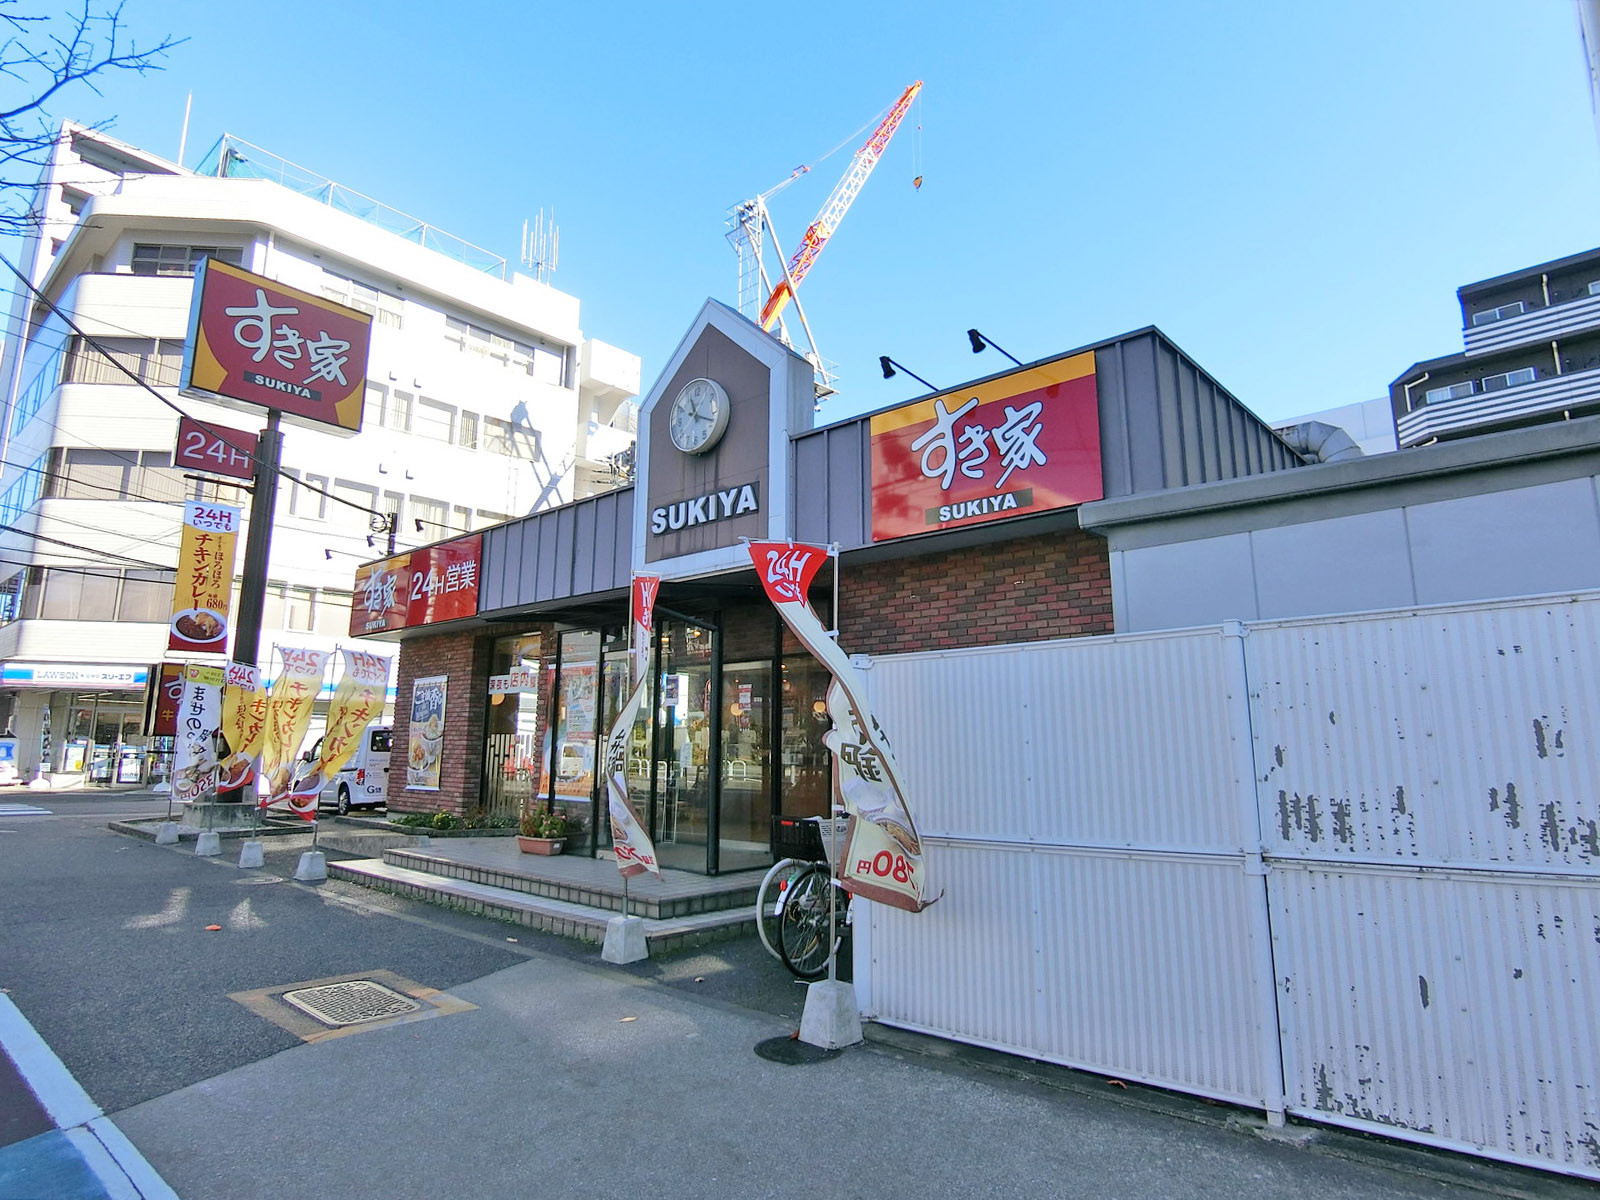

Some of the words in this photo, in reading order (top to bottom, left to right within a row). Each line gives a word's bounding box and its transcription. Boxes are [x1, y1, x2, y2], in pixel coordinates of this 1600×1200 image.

[225, 288, 351, 387] すき家
[254, 374, 312, 399] SUKIYA
[183, 431, 250, 469] 24H
[911, 396, 1047, 491] すき家
[193, 507, 232, 524] 24H
[651, 484, 758, 534] SUKIYA
[939, 492, 1018, 522] SUKIYA
[192, 519, 232, 532] いつでも
[191, 533, 213, 611] チキンカレー
[411, 559, 477, 601] 24H営業
[767, 550, 812, 584] 24H
[363, 566, 398, 618] すき家
[365, 618, 386, 630] SUKIYA
[36, 671, 79, 680] LAWSON
